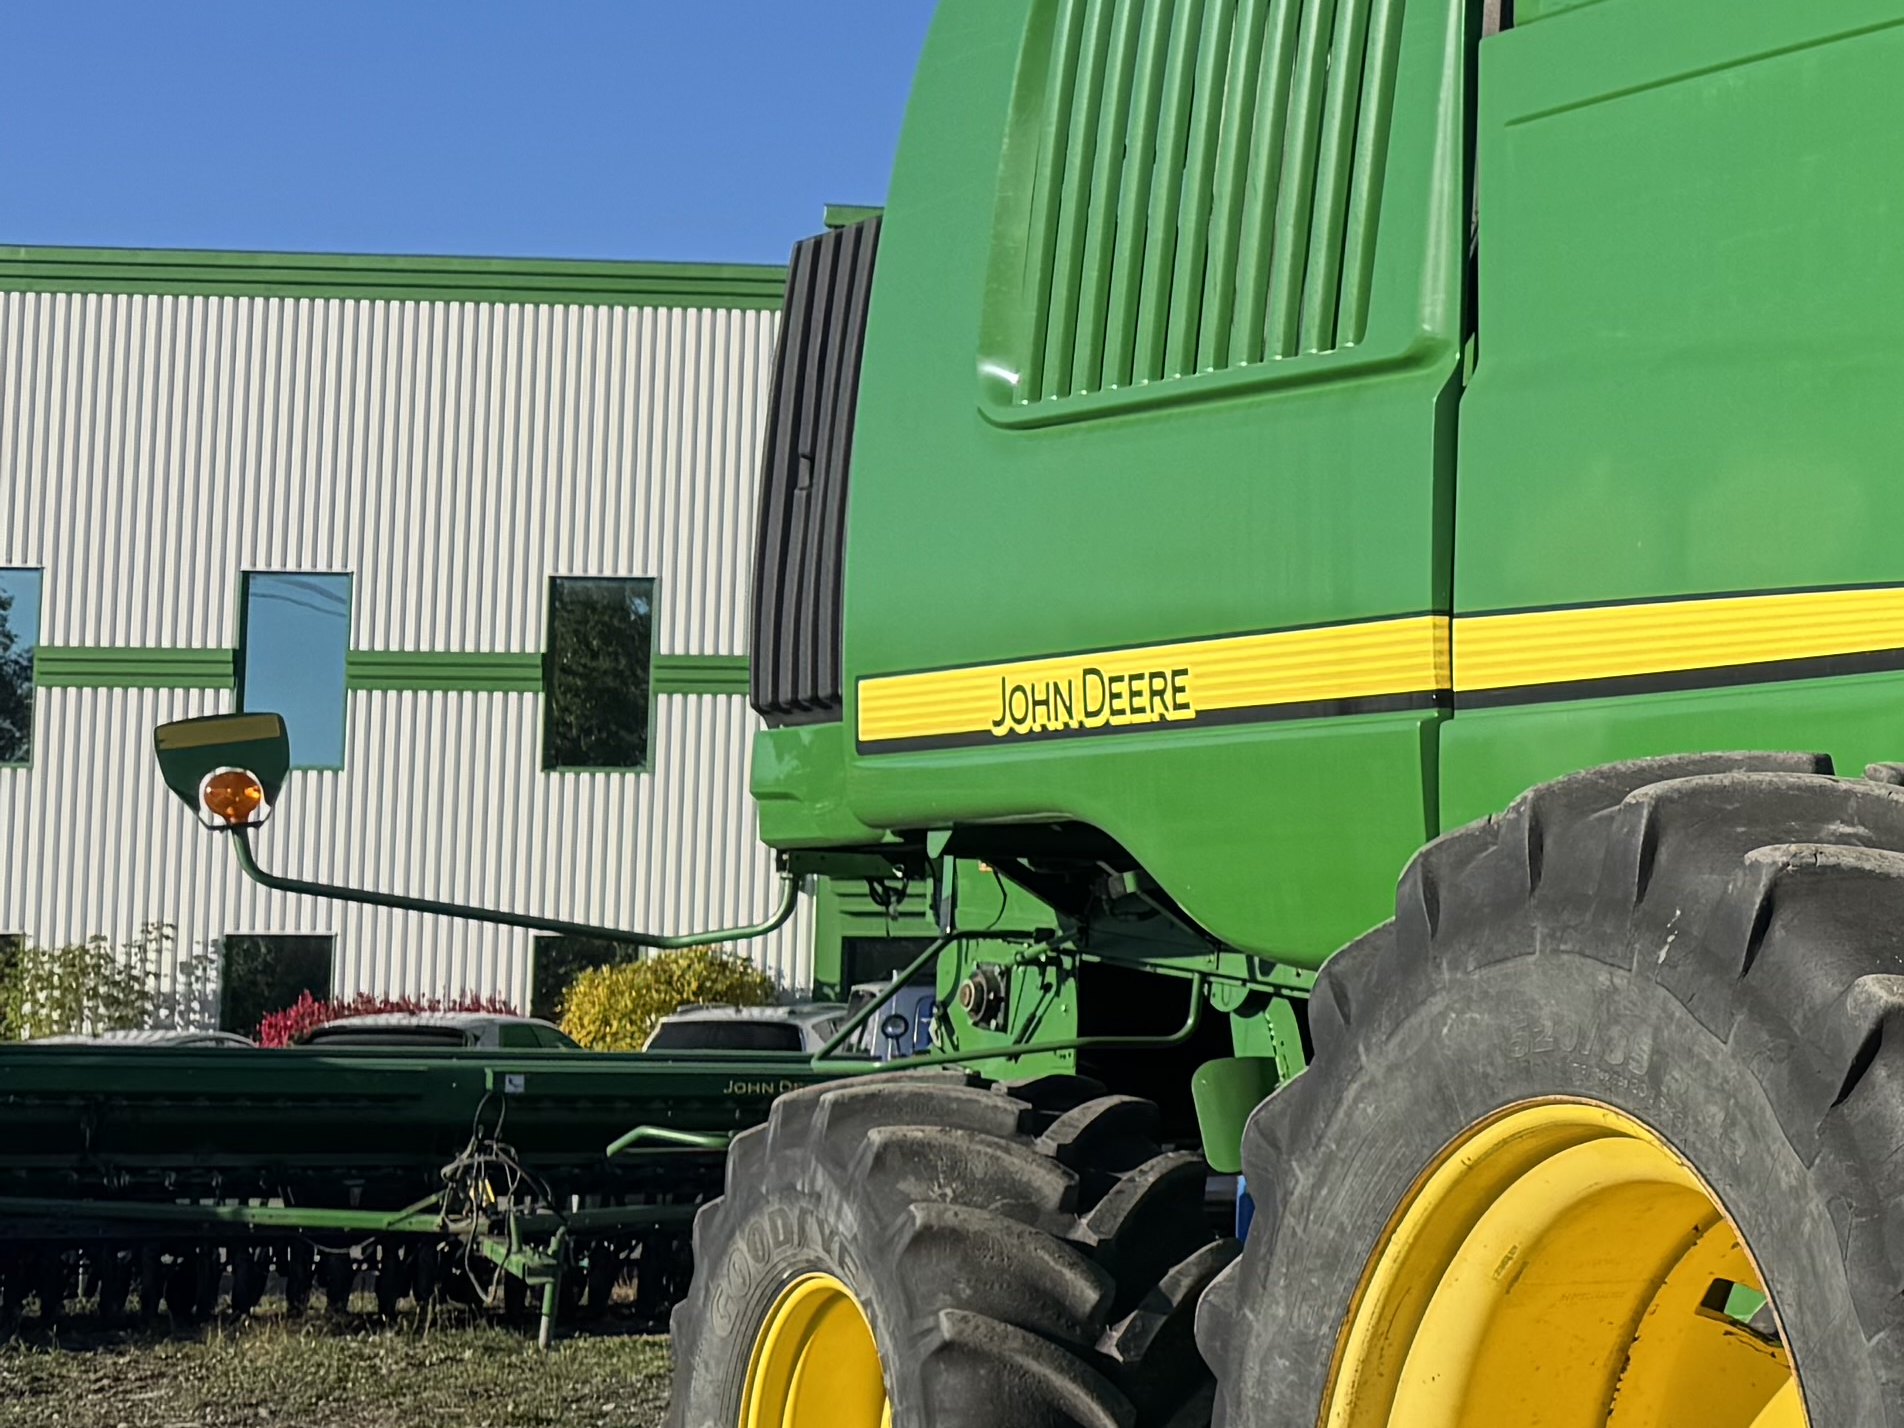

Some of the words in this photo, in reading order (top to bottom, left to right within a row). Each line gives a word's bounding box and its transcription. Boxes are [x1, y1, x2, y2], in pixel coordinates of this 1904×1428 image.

[992, 675, 1074, 729] JOHN
[1082, 667, 1191, 719] DEERE
[723, 1080, 774, 1095] JOHN
